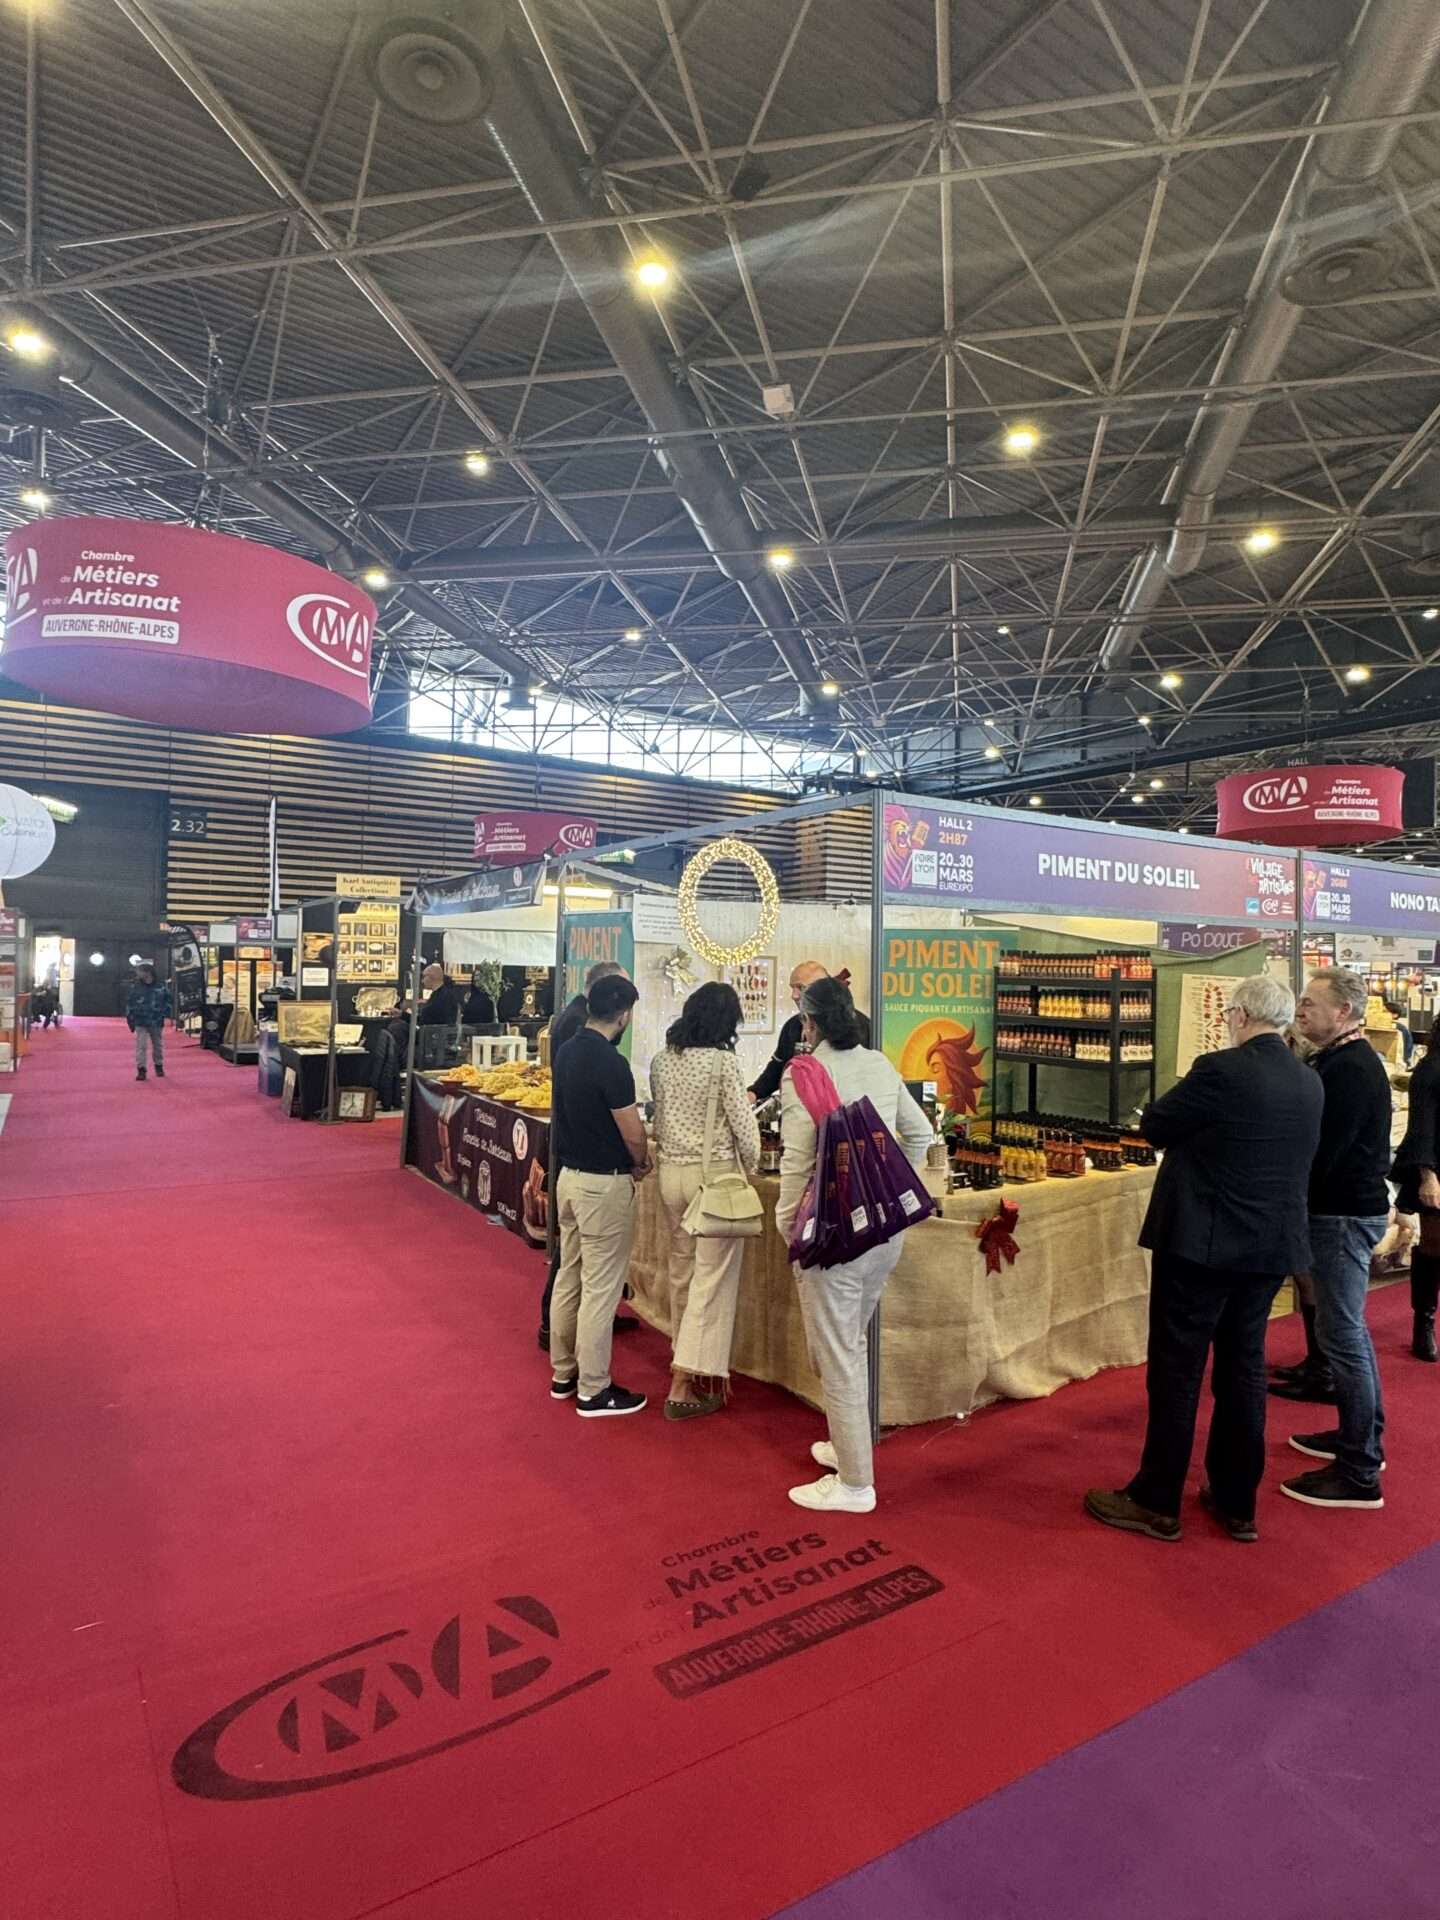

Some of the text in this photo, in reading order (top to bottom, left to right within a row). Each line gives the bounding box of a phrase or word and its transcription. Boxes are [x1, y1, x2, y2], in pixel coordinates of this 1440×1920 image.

[81, 551, 135, 562] Chambre
[73, 564, 160, 588] Métiers
[45, 618, 174, 639] AUVERGNE-RHÔNE-ALPES
[171, 818, 204, 834] 2.32
[938, 816, 974, 831] HALL 2
[939, 867, 974, 883] MARS
[1038, 852, 1201, 890] PIMENT DU SOLEIL
[939, 881, 974, 893] EUREXPO
[1390, 891, 1440, 913] NONO TA
[570, 927, 622, 961] PIMENT
[888, 938, 1000, 970] PIMENT
[882, 971, 994, 999] DU SOLEI
[884, 1002, 909, 1013] SAUCE
[910, 1003, 949, 1014] PIQUANTE
[661, 1530, 761, 1568] Chambre
[664, 1532, 828, 1600] Métiers
[669, 1571, 932, 1687] AUVERGNE-RHÔNE-ALPES
